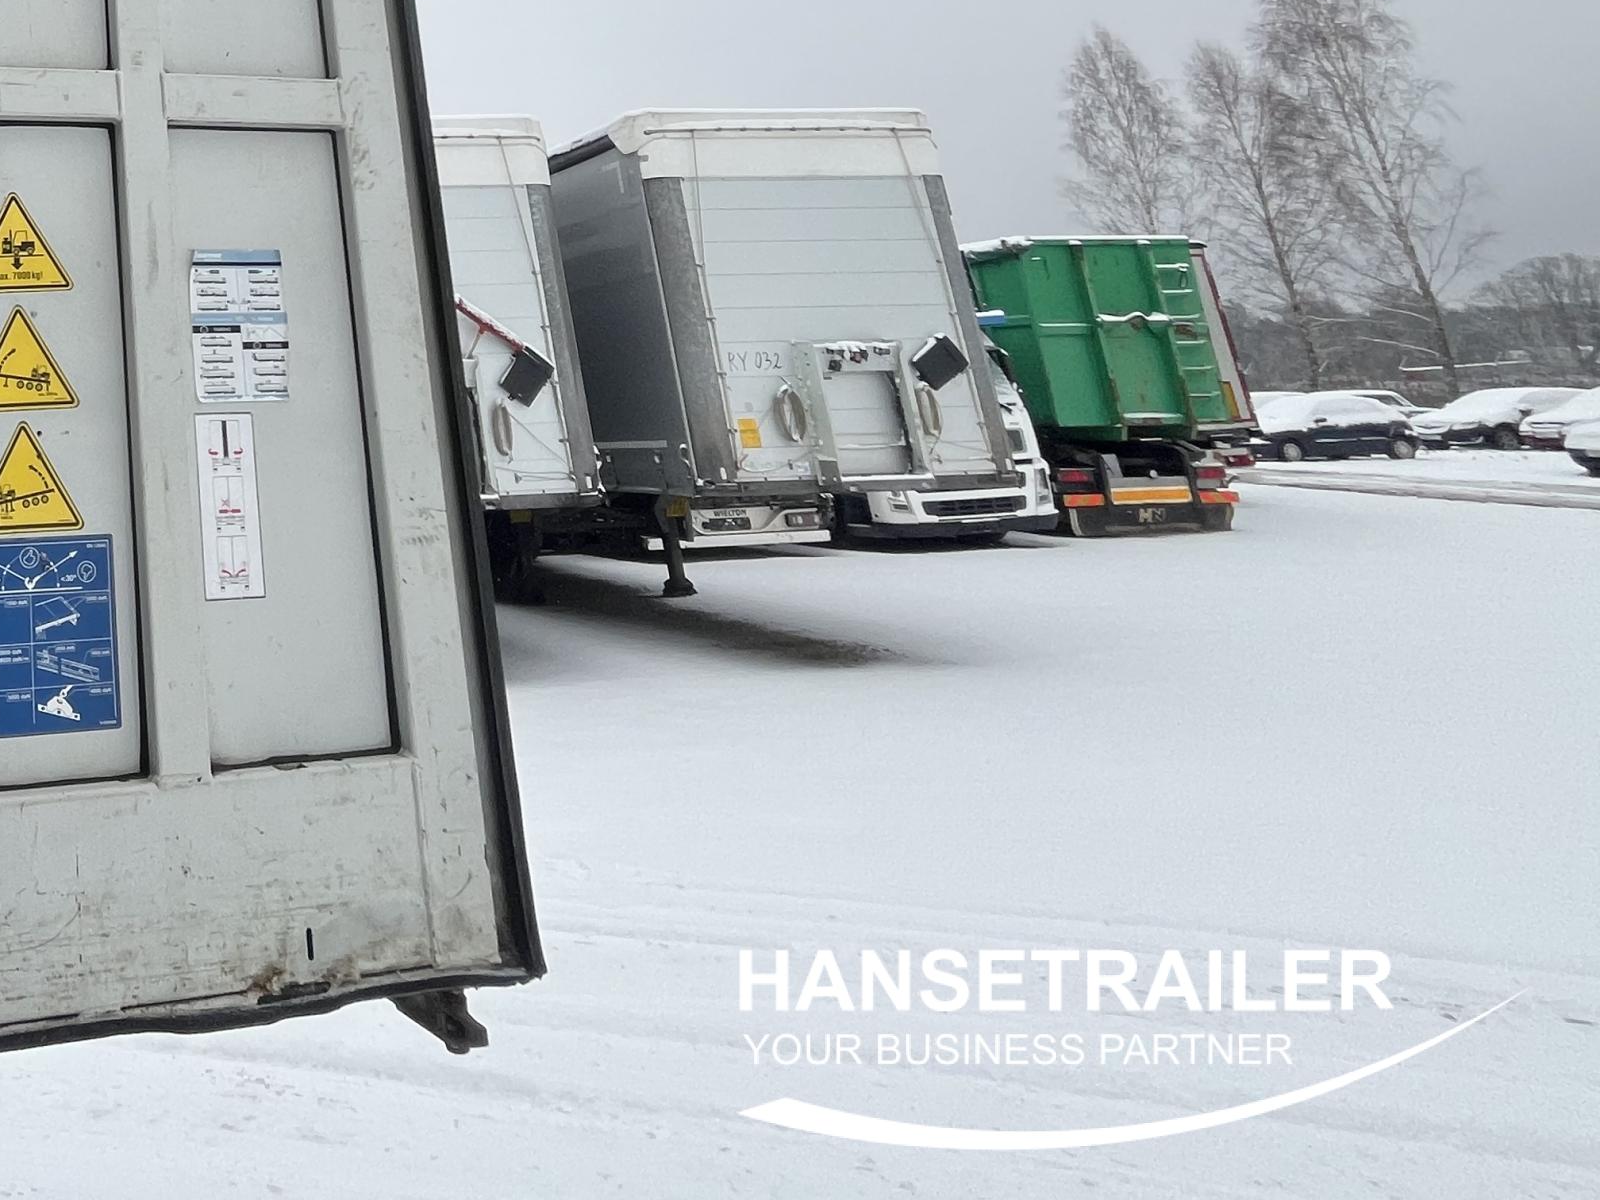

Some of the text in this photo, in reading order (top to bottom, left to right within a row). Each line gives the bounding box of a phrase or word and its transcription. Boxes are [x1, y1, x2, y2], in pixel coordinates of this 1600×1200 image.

[728, 351, 783, 372] RY 032
[713, 509, 747, 517] WIELTON
